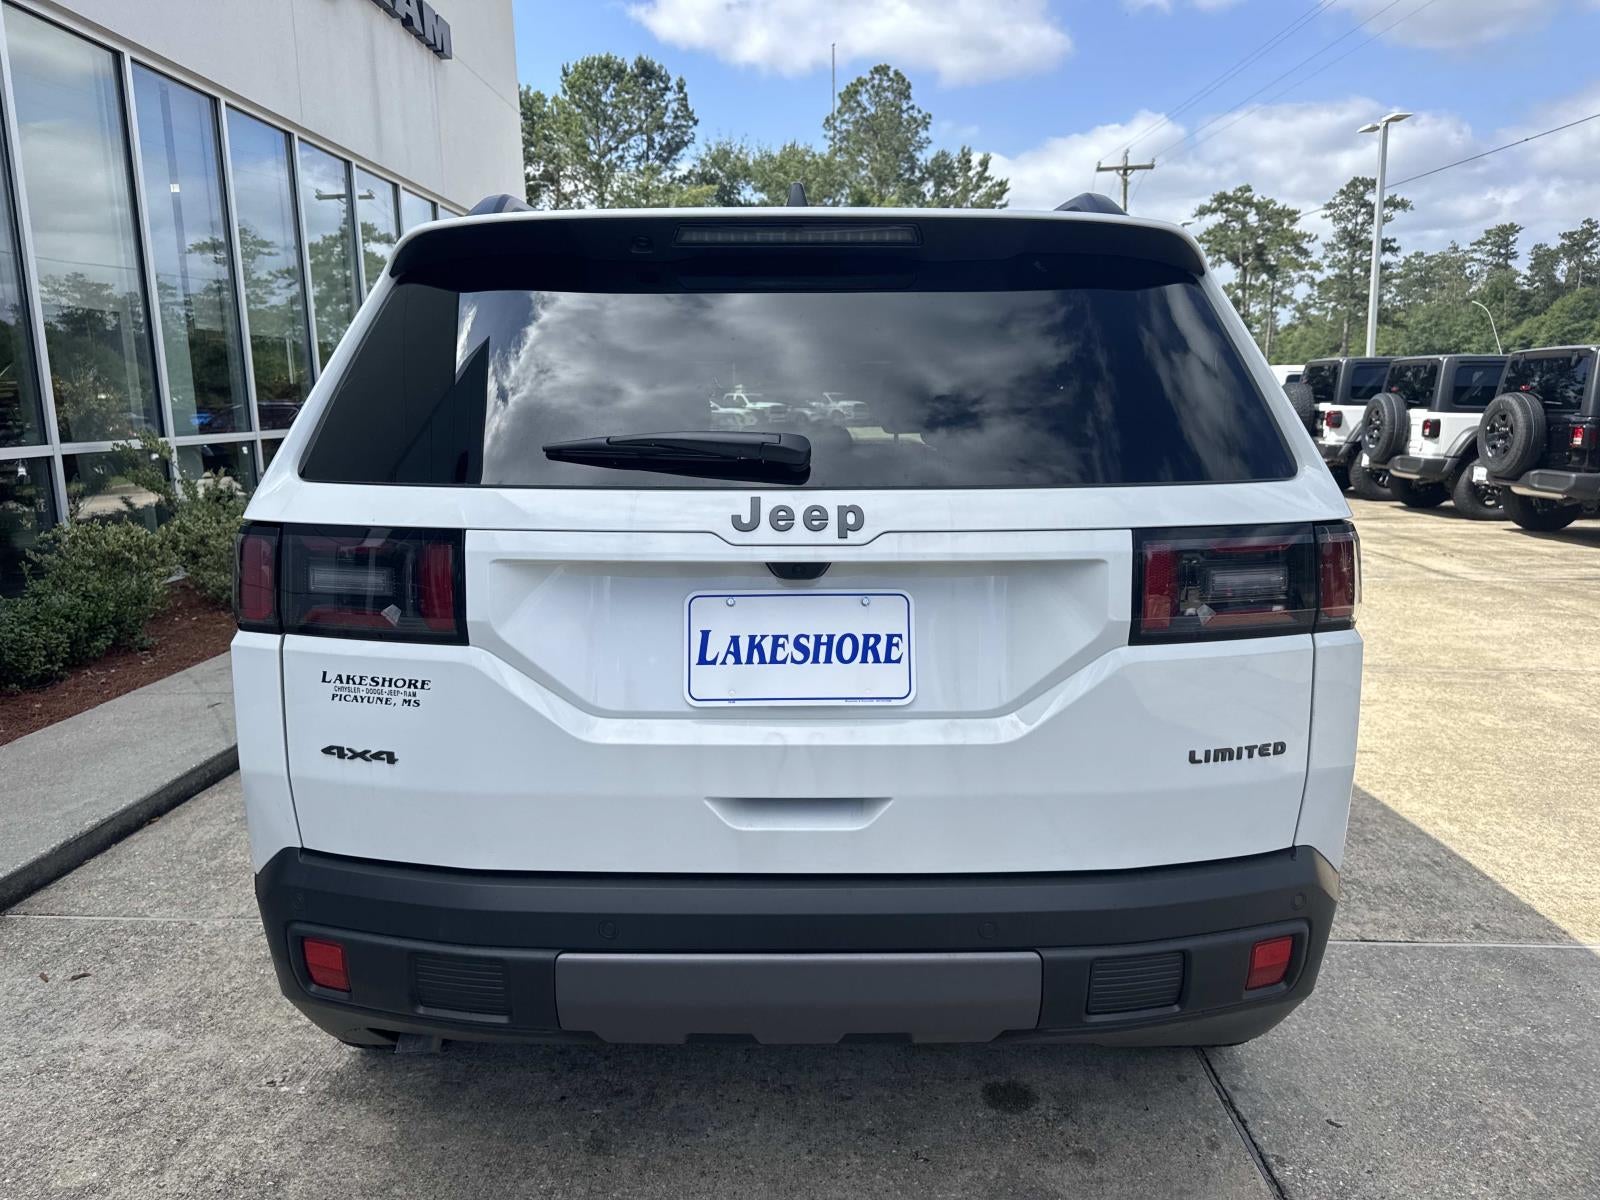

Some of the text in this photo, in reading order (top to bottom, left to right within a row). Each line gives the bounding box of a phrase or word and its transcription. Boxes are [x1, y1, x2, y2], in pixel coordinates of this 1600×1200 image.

[371, 0, 452, 59] AM
[731, 496, 865, 539] Jeep
[696, 629, 904, 666] LAKESHORE
[321, 670, 431, 690] LAKESHORE
[331, 693, 421, 707] PICAYUNE, MS
[1188, 741, 1287, 764] LIMITED
